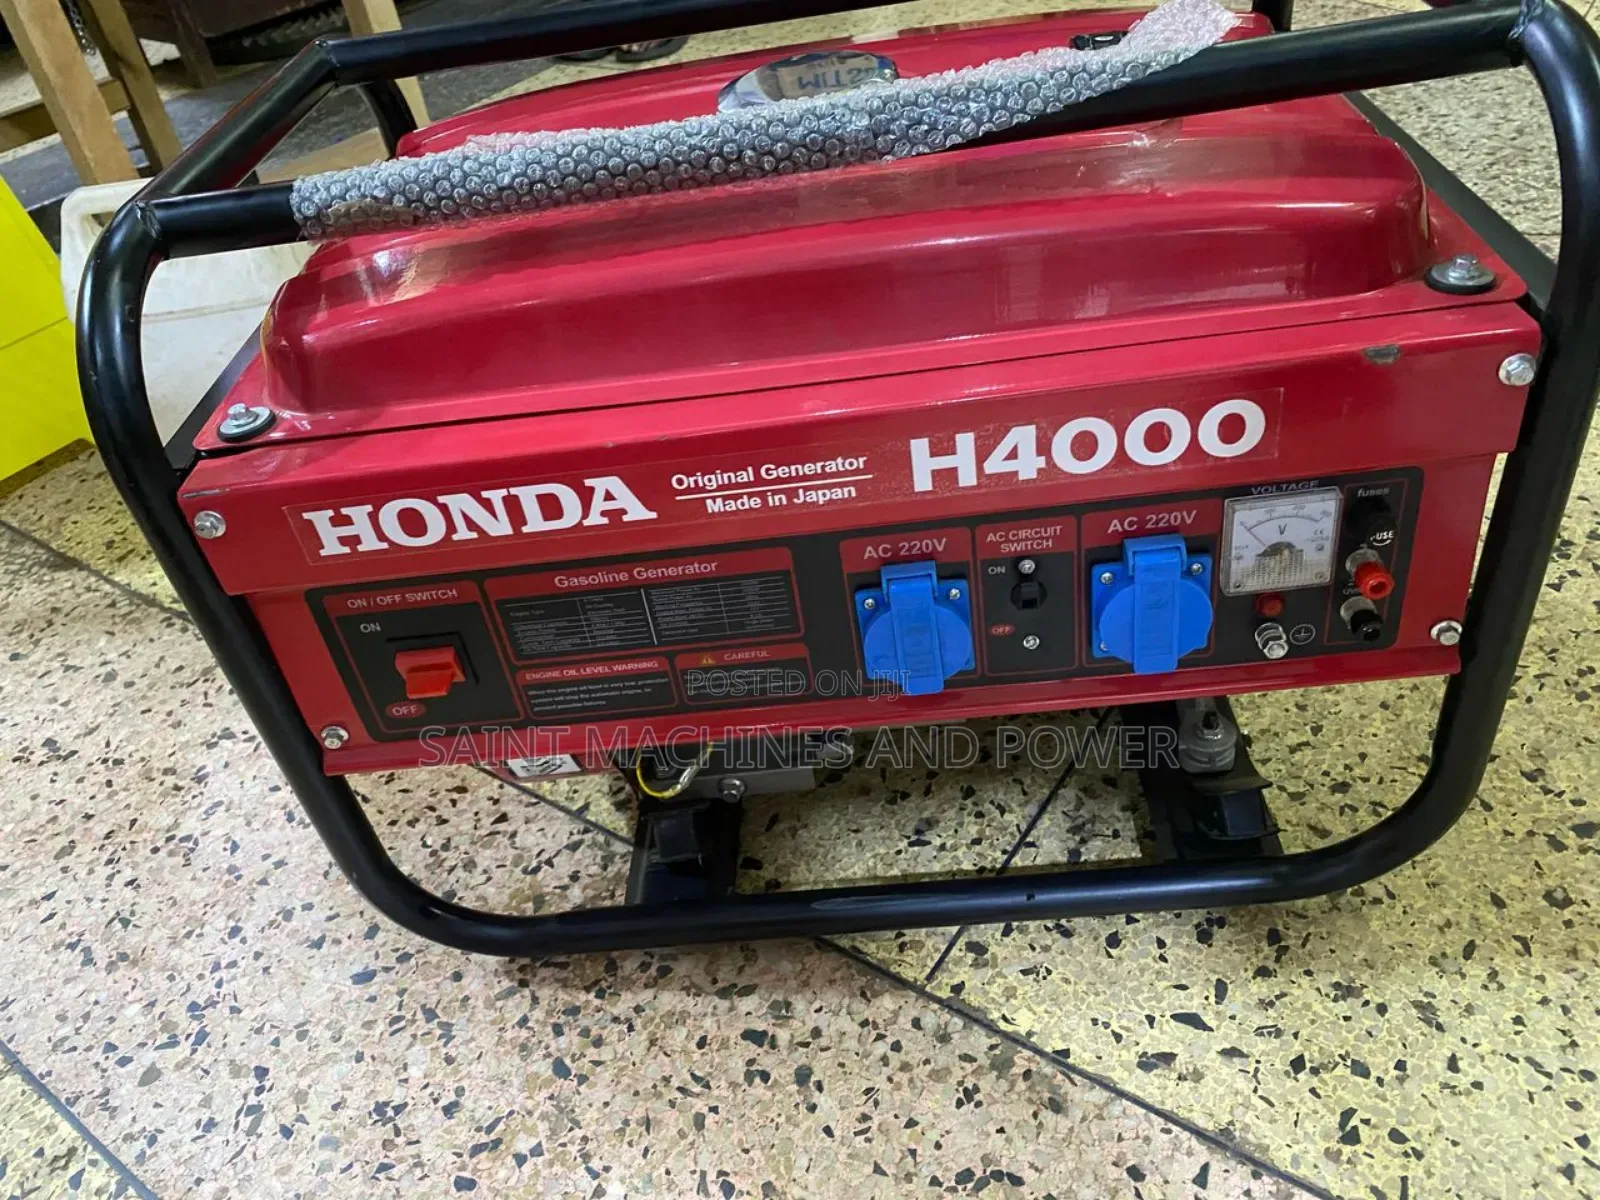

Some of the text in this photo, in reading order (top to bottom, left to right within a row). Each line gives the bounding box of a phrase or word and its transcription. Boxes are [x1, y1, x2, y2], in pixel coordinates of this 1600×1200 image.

[910, 399, 1266, 492] H4000
[671, 456, 867, 490] Original Generator
[1250, 480, 1319, 495] VOLTAGE
[705, 484, 857, 514] Made in Japan
[302, 476, 657, 557] HONDA
[1107, 509, 1197, 534] AC 220V
[986, 525, 1063, 543] AC CIRCUIT
[863, 537, 947, 560] AC 220V
[1000, 538, 1053, 553] SWITCH
[554, 561, 718, 588] Gasoline Generator
[988, 566, 1006, 575] ON
[347, 598, 367, 609] ON
[377, 594, 404, 606] OFF
[405, 588, 458, 603] SWITCH
[360, 622, 381, 633] ON
[724, 649, 770, 662] CAREFUL
[525, 661, 659, 681] ENGINE OIL LEVEL WARNING
[392, 705, 418, 716] OFF
